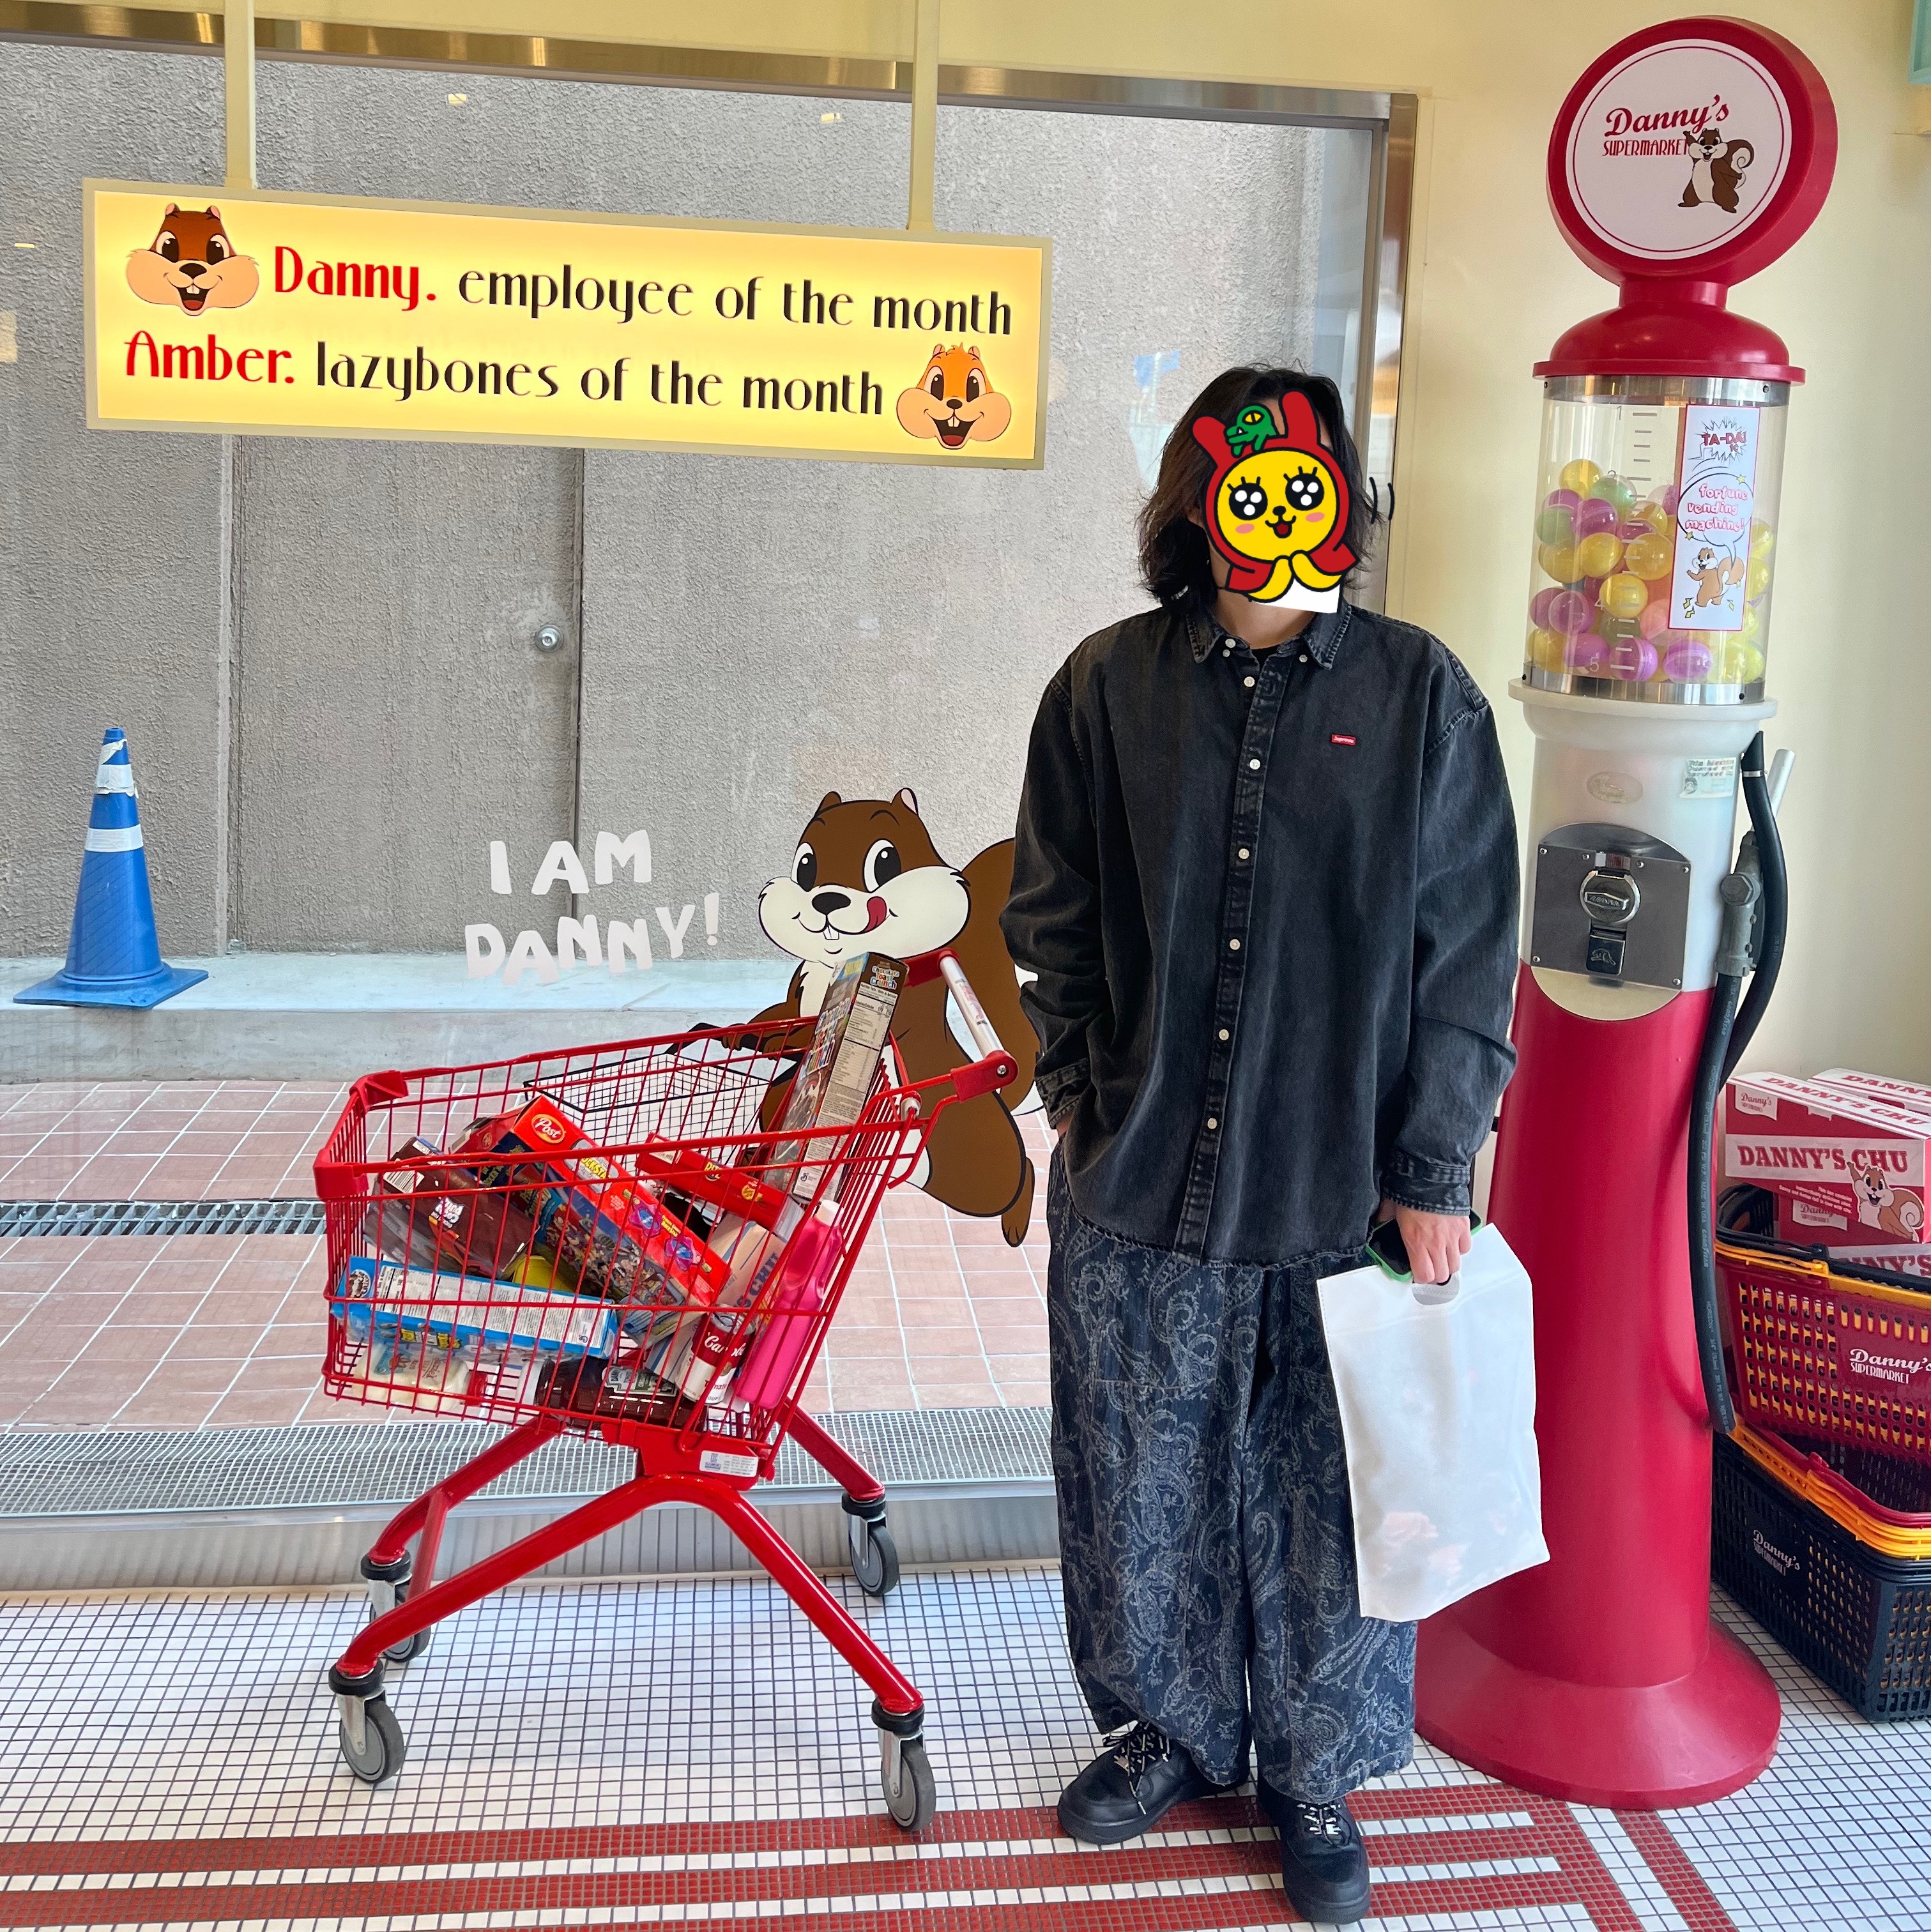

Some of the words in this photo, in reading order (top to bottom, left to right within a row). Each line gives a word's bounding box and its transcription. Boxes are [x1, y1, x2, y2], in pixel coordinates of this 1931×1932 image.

[1604, 95, 1729, 137] Danny's
[1602, 139, 1688, 156] SUPERMARKET
[274, 245, 436, 311] Danny.
[458, 264, 694, 324] employee
[715, 276, 764, 320] of
[783, 279, 854, 326] the
[873, 291, 1011, 335] month
[125, 330, 295, 384] Amber.
[317, 341, 559, 402] lazybones
[581, 358, 630, 401] of
[652, 361, 722, 406] the
[743, 371, 883, 415] month
[1699, 483, 1748, 501] fortune
[1687, 501, 1739, 515] vending
[1684, 516, 1745, 532] machine!
[490, 840, 512, 894] I
[531, 830, 652, 895] AM
[464, 892, 719, 985] DANNY!
[1741, 1092, 1772, 1106] Danny's
[1763, 1077, 1869, 1109] DANNY'S
[1870, 1108, 1927, 1125] CHU
[535, 1117, 563, 1139] Post
[1737, 1145, 1847, 1170] DANNY'S
[1851, 1150, 1909, 1173] CHU
[1851, 1362, 1909, 1384] SUPERMARKET
[1753, 1530, 1801, 1571] Danny's
